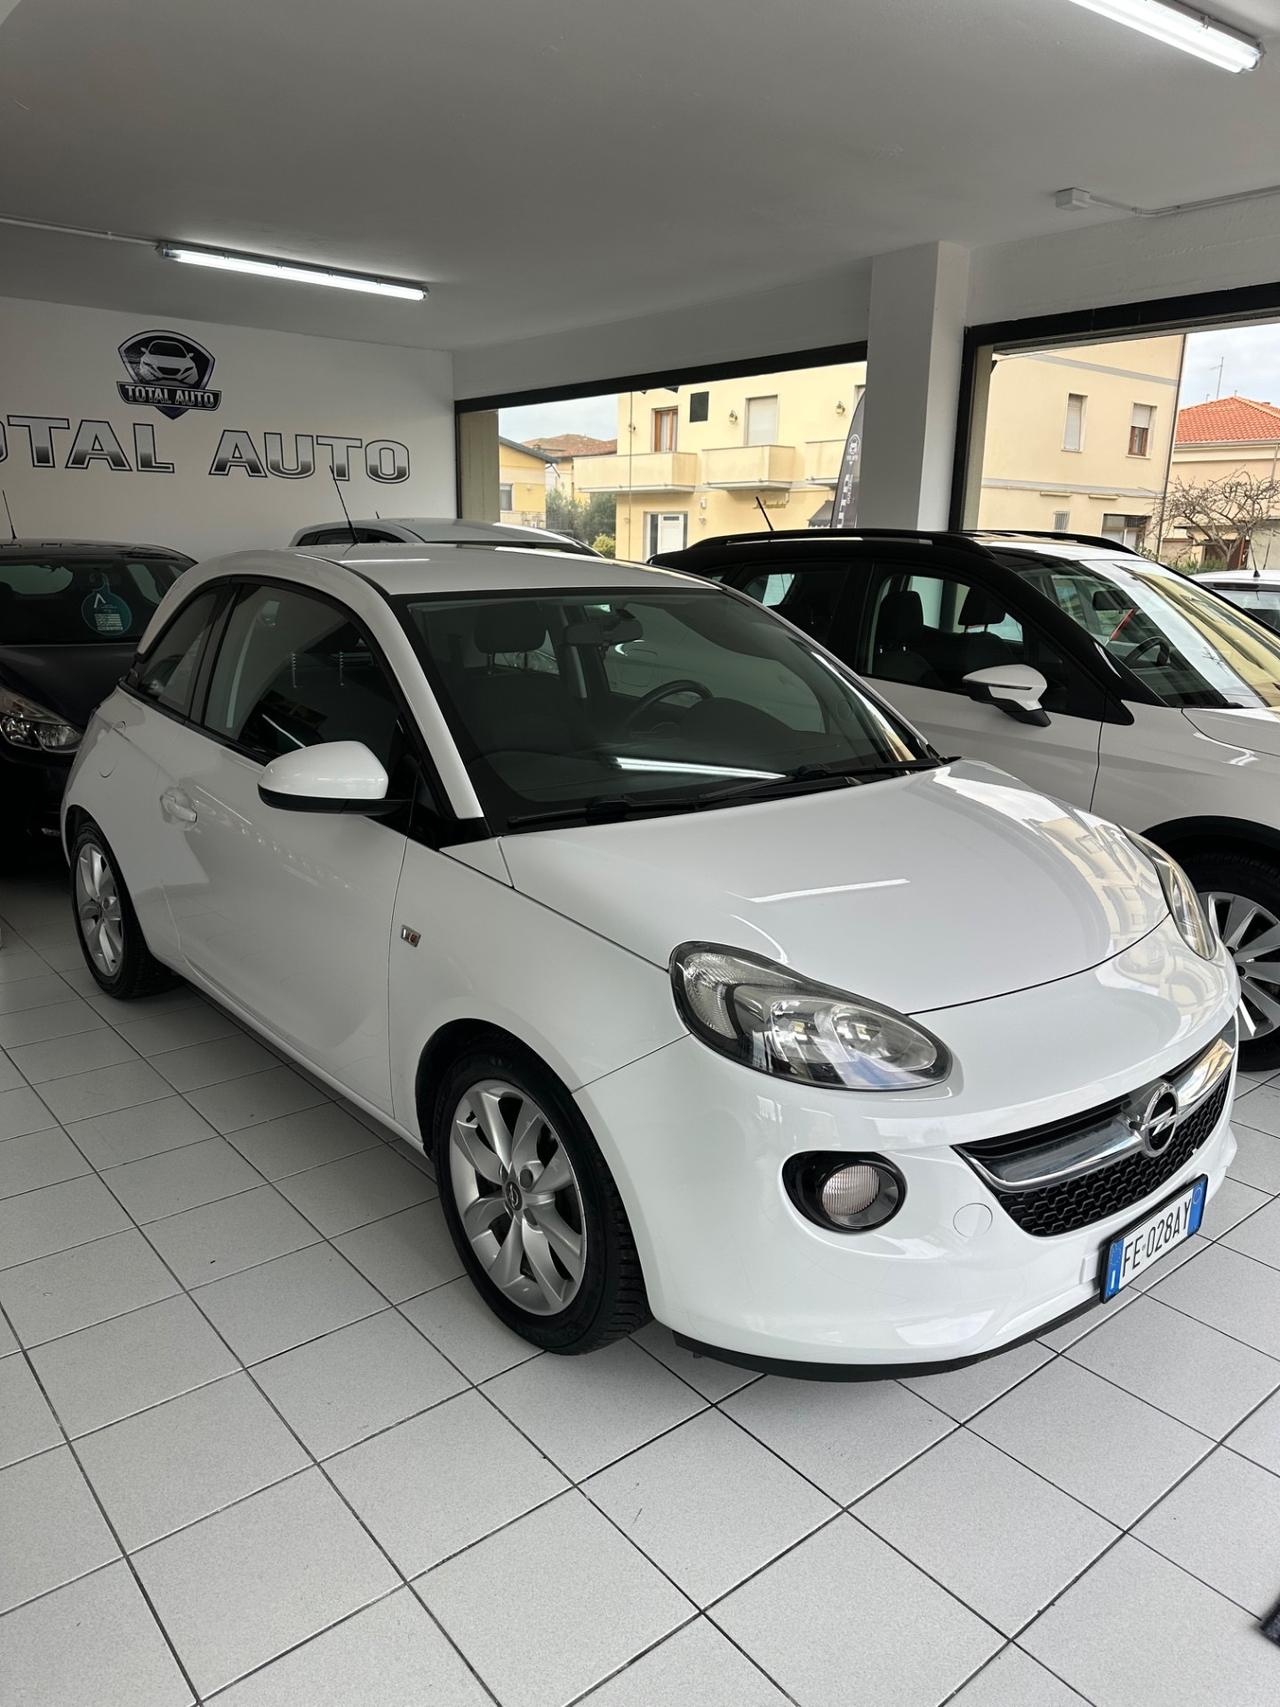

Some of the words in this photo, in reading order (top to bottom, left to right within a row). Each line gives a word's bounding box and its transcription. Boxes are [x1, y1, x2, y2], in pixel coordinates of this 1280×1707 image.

[125, 385, 172, 404] TOTAL
[175, 389, 214, 408] AUTO
[0, 415, 175, 474] TAL
[208, 429, 410, 484] AUTO
